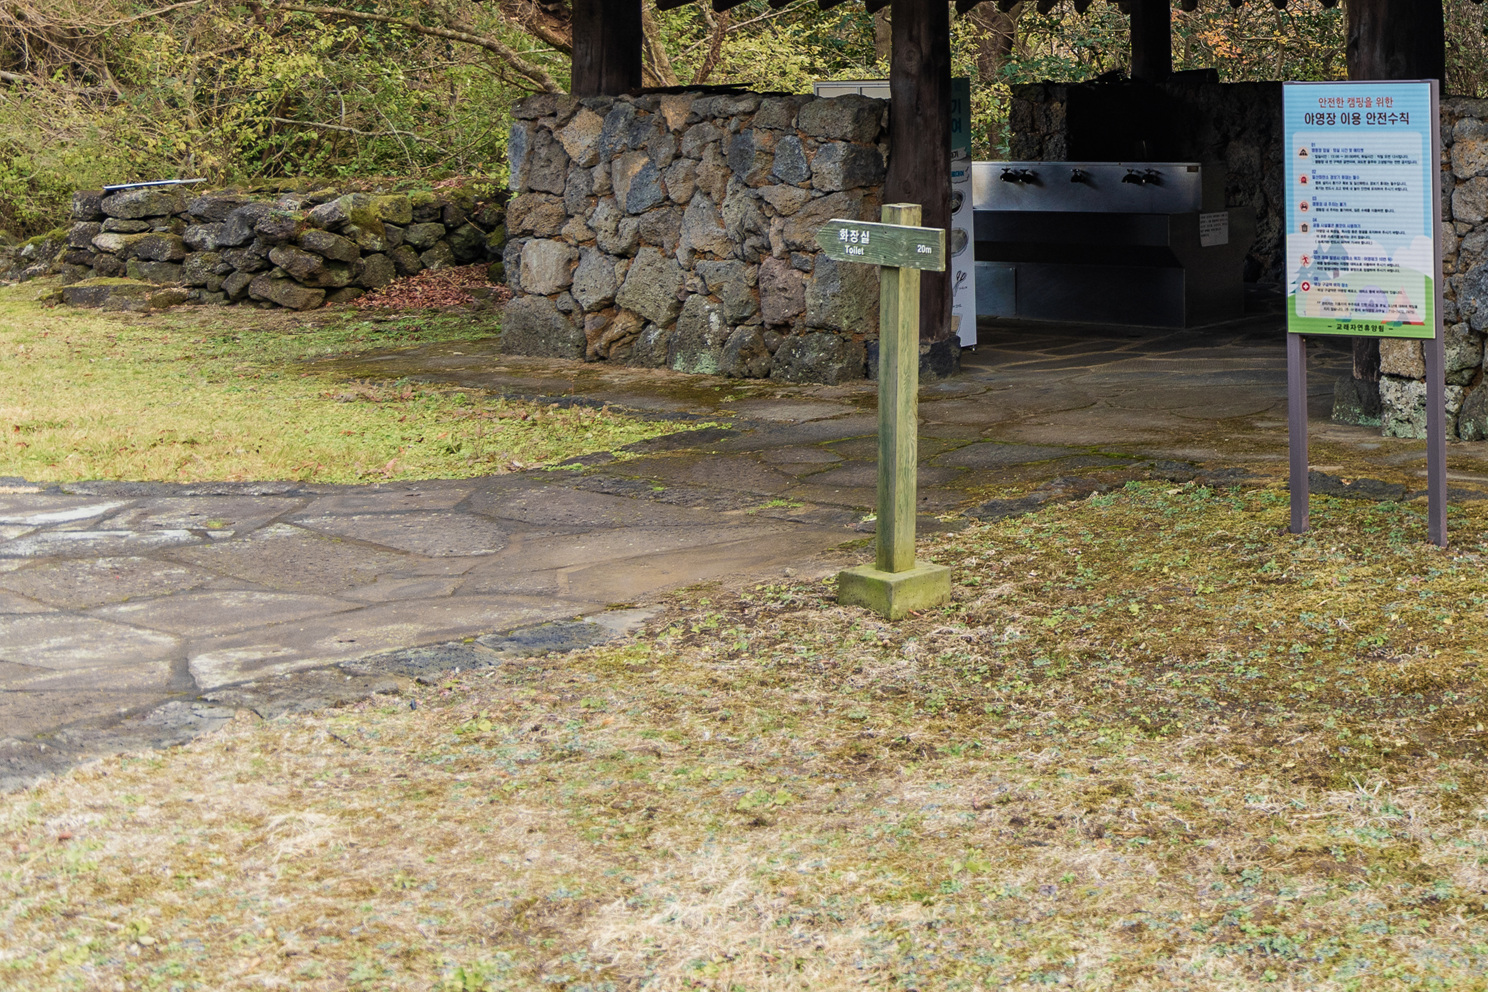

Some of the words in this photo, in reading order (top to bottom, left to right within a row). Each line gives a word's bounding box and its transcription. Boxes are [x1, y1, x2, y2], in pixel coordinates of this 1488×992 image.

[1318, 97, 1345, 108] 안전한
[1347, 97, 1373, 108] 캠핑을
[1375, 97, 1394, 108] 위한
[1304, 112, 1336, 126] 야영장
[1340, 112, 1361, 125] 이용
[1365, 112, 1410, 126] 안전수칙
[839, 228, 870, 244] 화장실
[844, 245, 865, 256] Toilet
[917, 244, 932, 254] 20m
